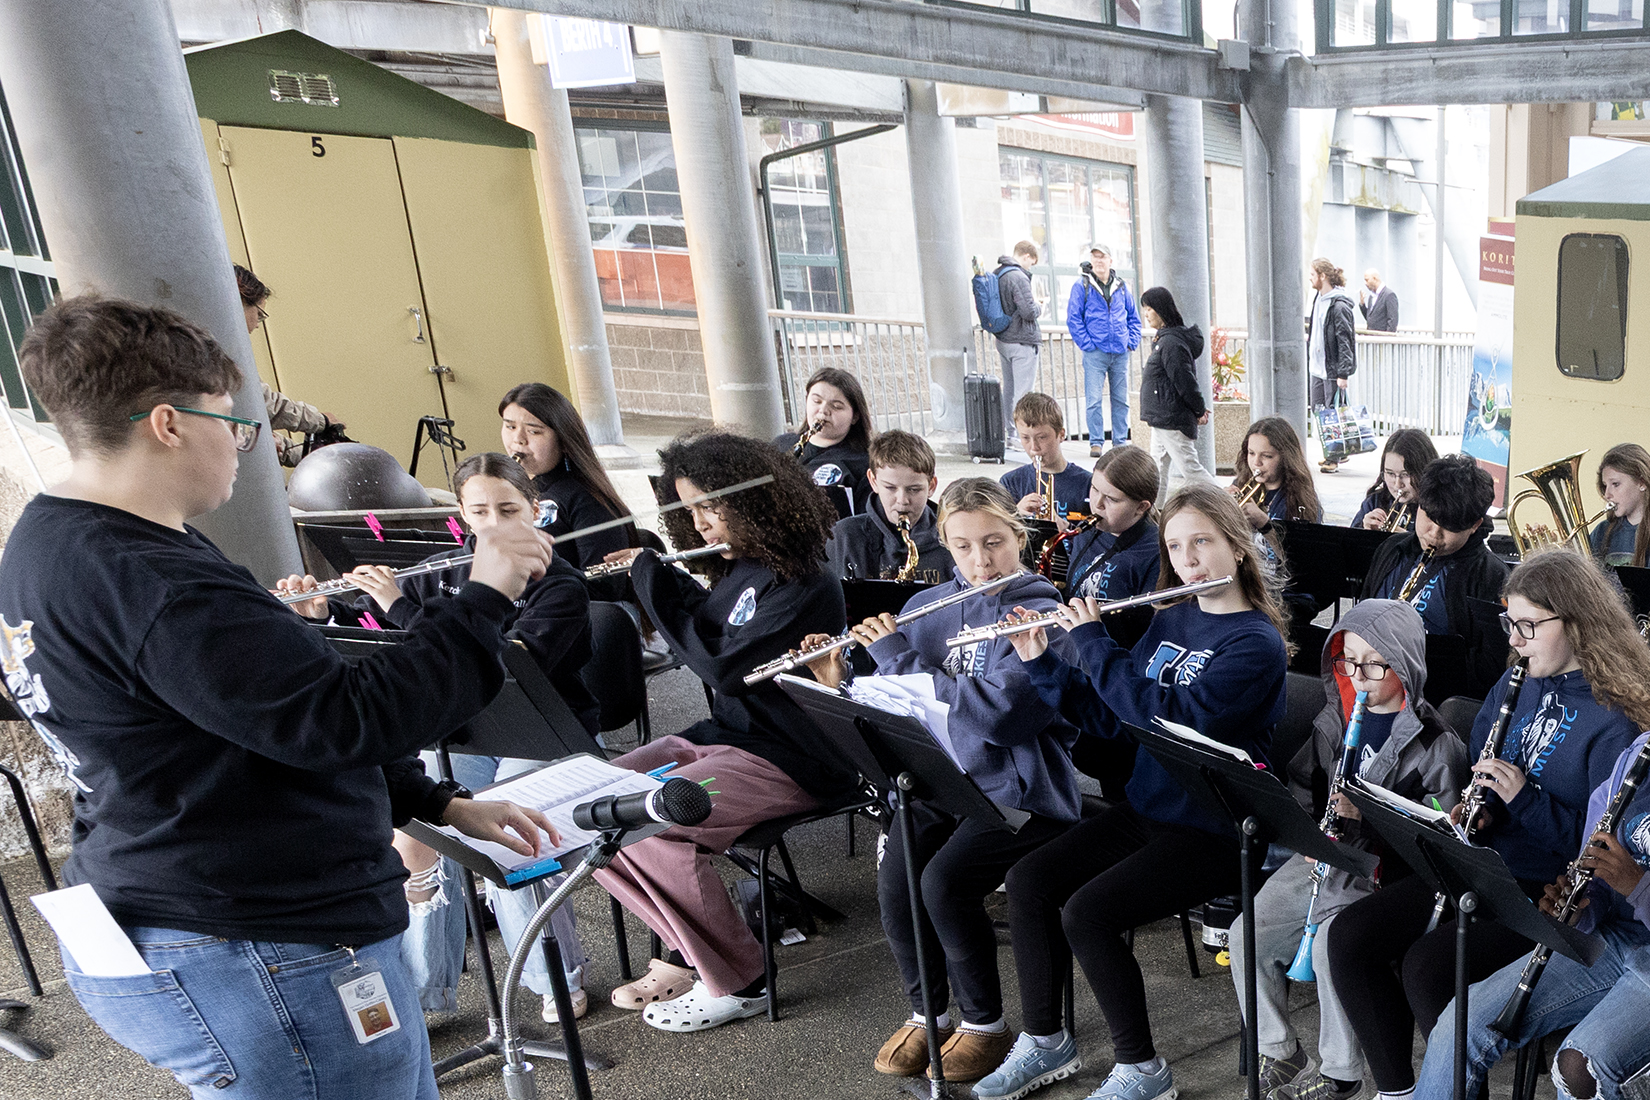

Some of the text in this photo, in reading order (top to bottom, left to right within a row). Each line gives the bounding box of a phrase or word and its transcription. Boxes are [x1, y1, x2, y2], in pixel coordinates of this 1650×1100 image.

[311, 136, 326, 157] 5
[1482, 250, 1515, 266] KORIT
[1416, 574, 1440, 613] USIC
[1530, 706, 1579, 778] MUSIC
